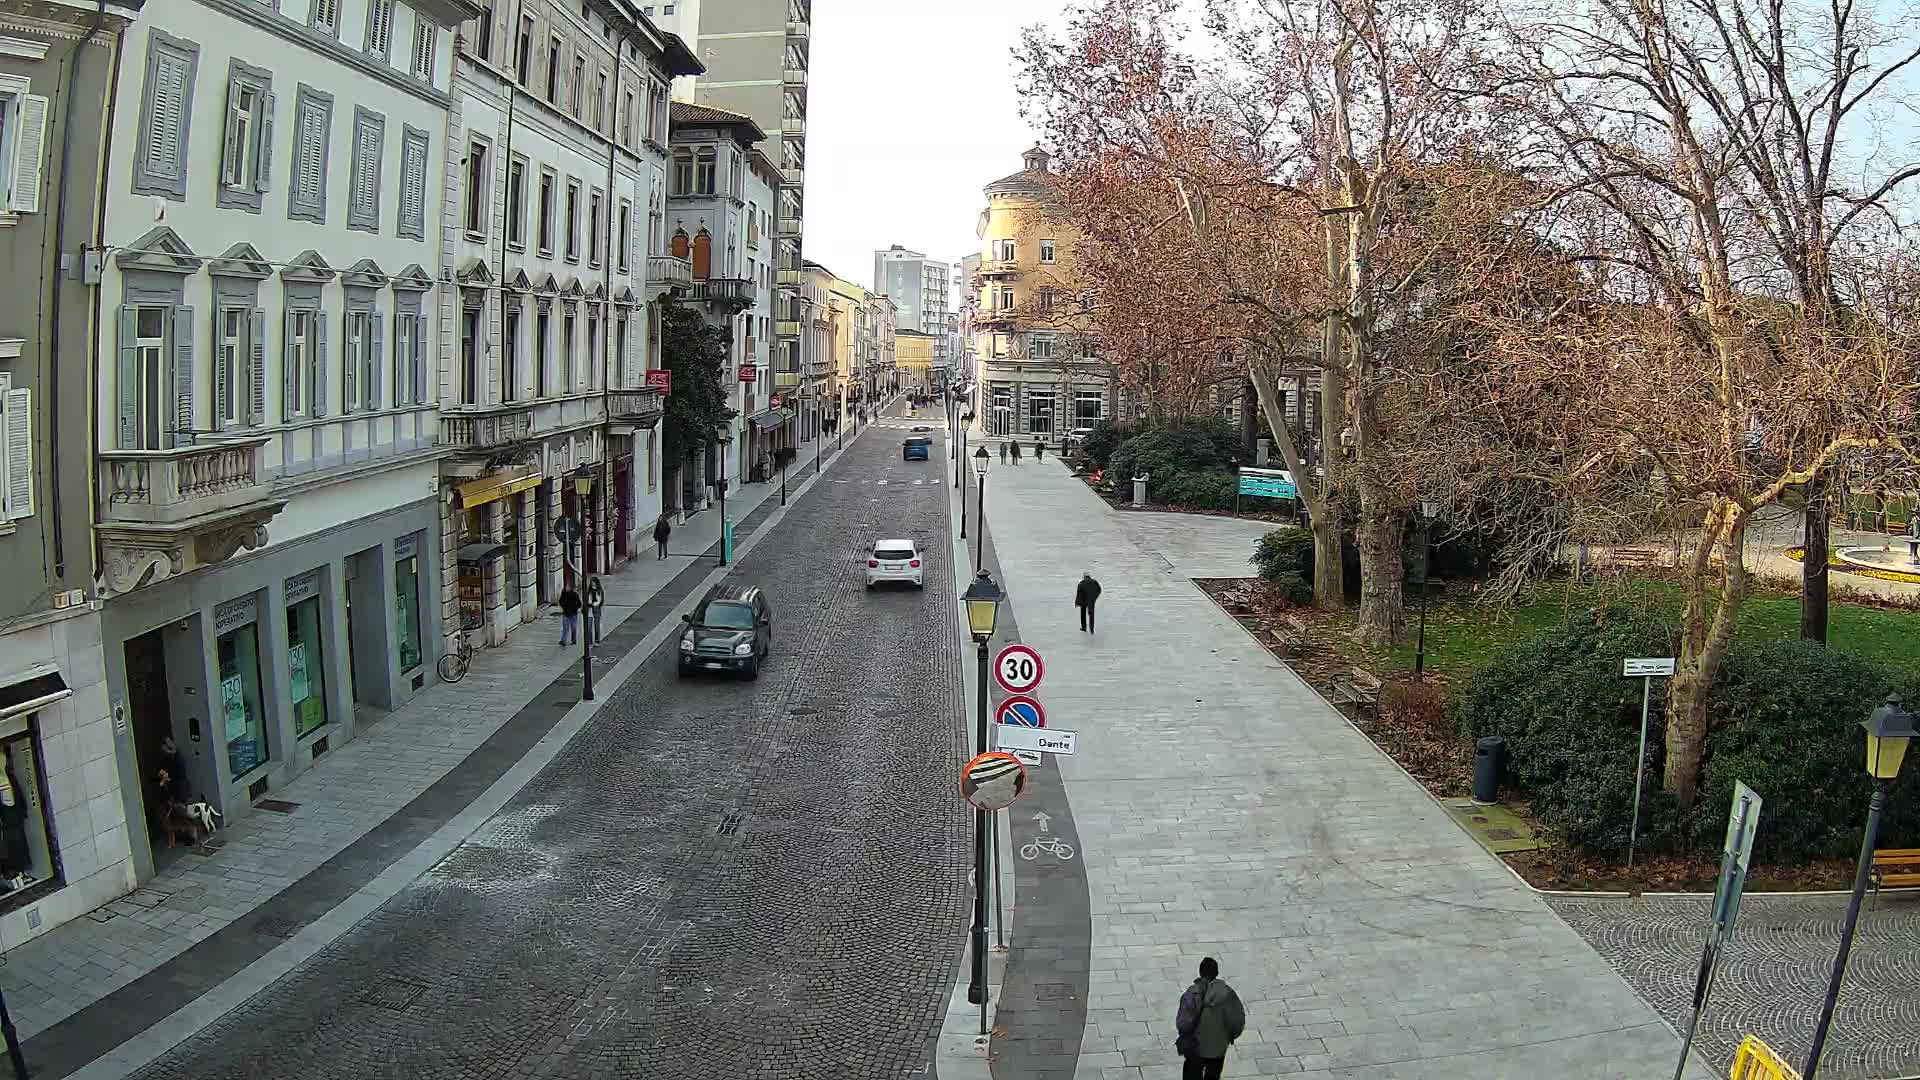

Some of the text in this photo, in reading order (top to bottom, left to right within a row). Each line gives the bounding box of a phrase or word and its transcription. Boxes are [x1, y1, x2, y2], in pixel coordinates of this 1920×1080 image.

[1006, 658, 1033, 680] 30
[222, 678, 240, 701] 130
[1039, 738, 1070, 750] Dante
